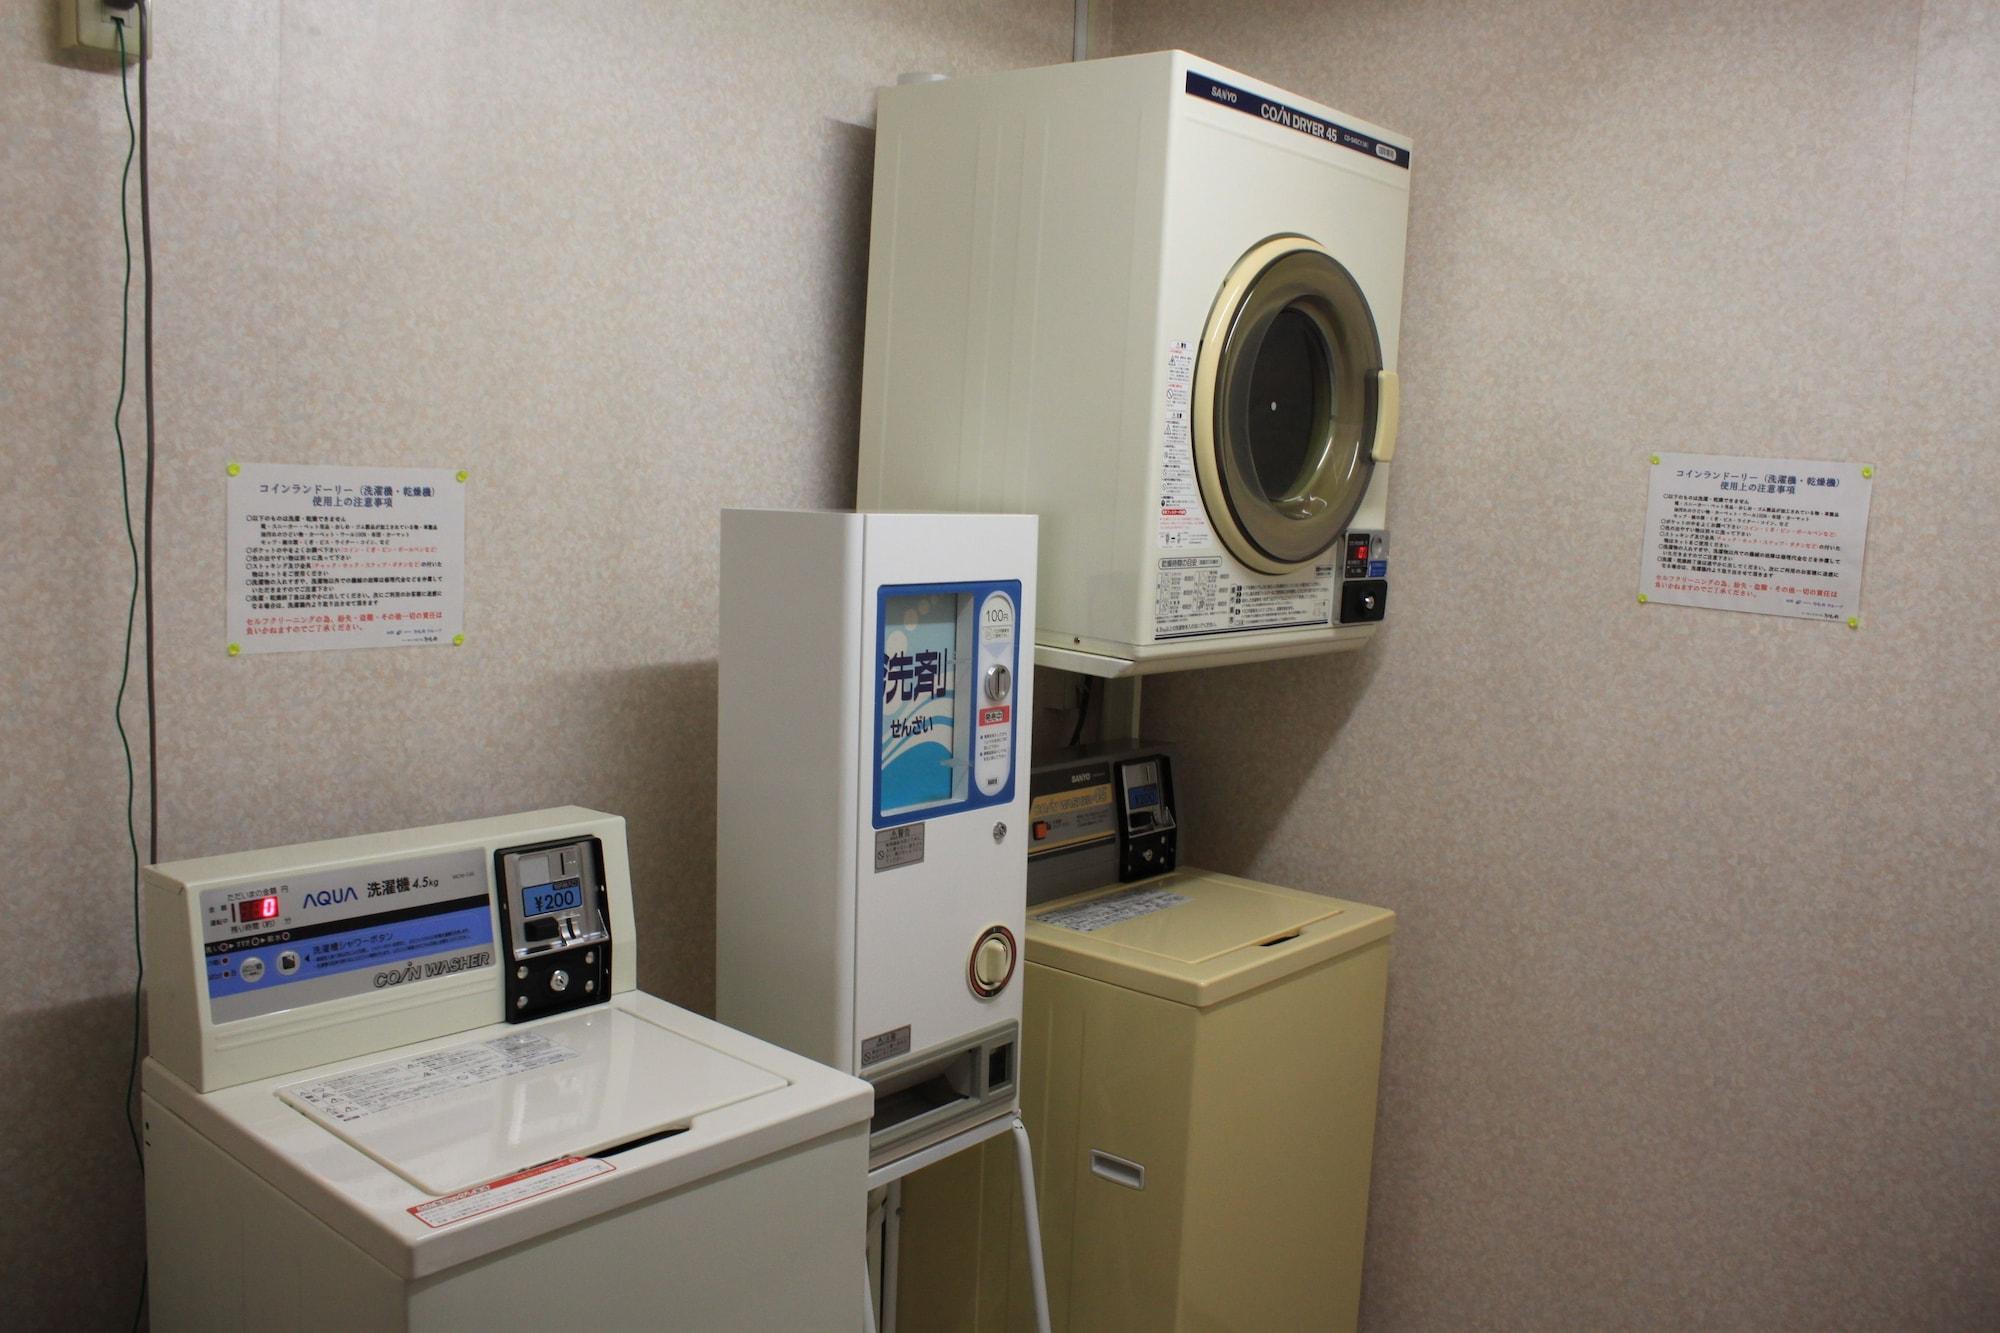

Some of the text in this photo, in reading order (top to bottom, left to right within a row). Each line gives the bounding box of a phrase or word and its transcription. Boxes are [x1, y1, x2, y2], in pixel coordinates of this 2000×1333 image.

[1211, 86, 1237, 103] SANYO
[1292, 117, 1325, 138] DRYER
[1325, 127, 1338, 142] 45
[1720, 481, 1795, 494] 使用上の注意事項
[312, 495, 392, 507] 使用上の注意事項
[883, 647, 948, 704] 洗剤
[890, 716, 933, 739] せんざい
[303, 887, 358, 909] AQUA
[367, 876, 411, 898] 洗濯機
[412, 876, 440, 890] 4.5kg
[263, 897, 276, 917] 0
[534, 890, 575, 912] ¥200
[425, 951, 491, 977] WASHER
